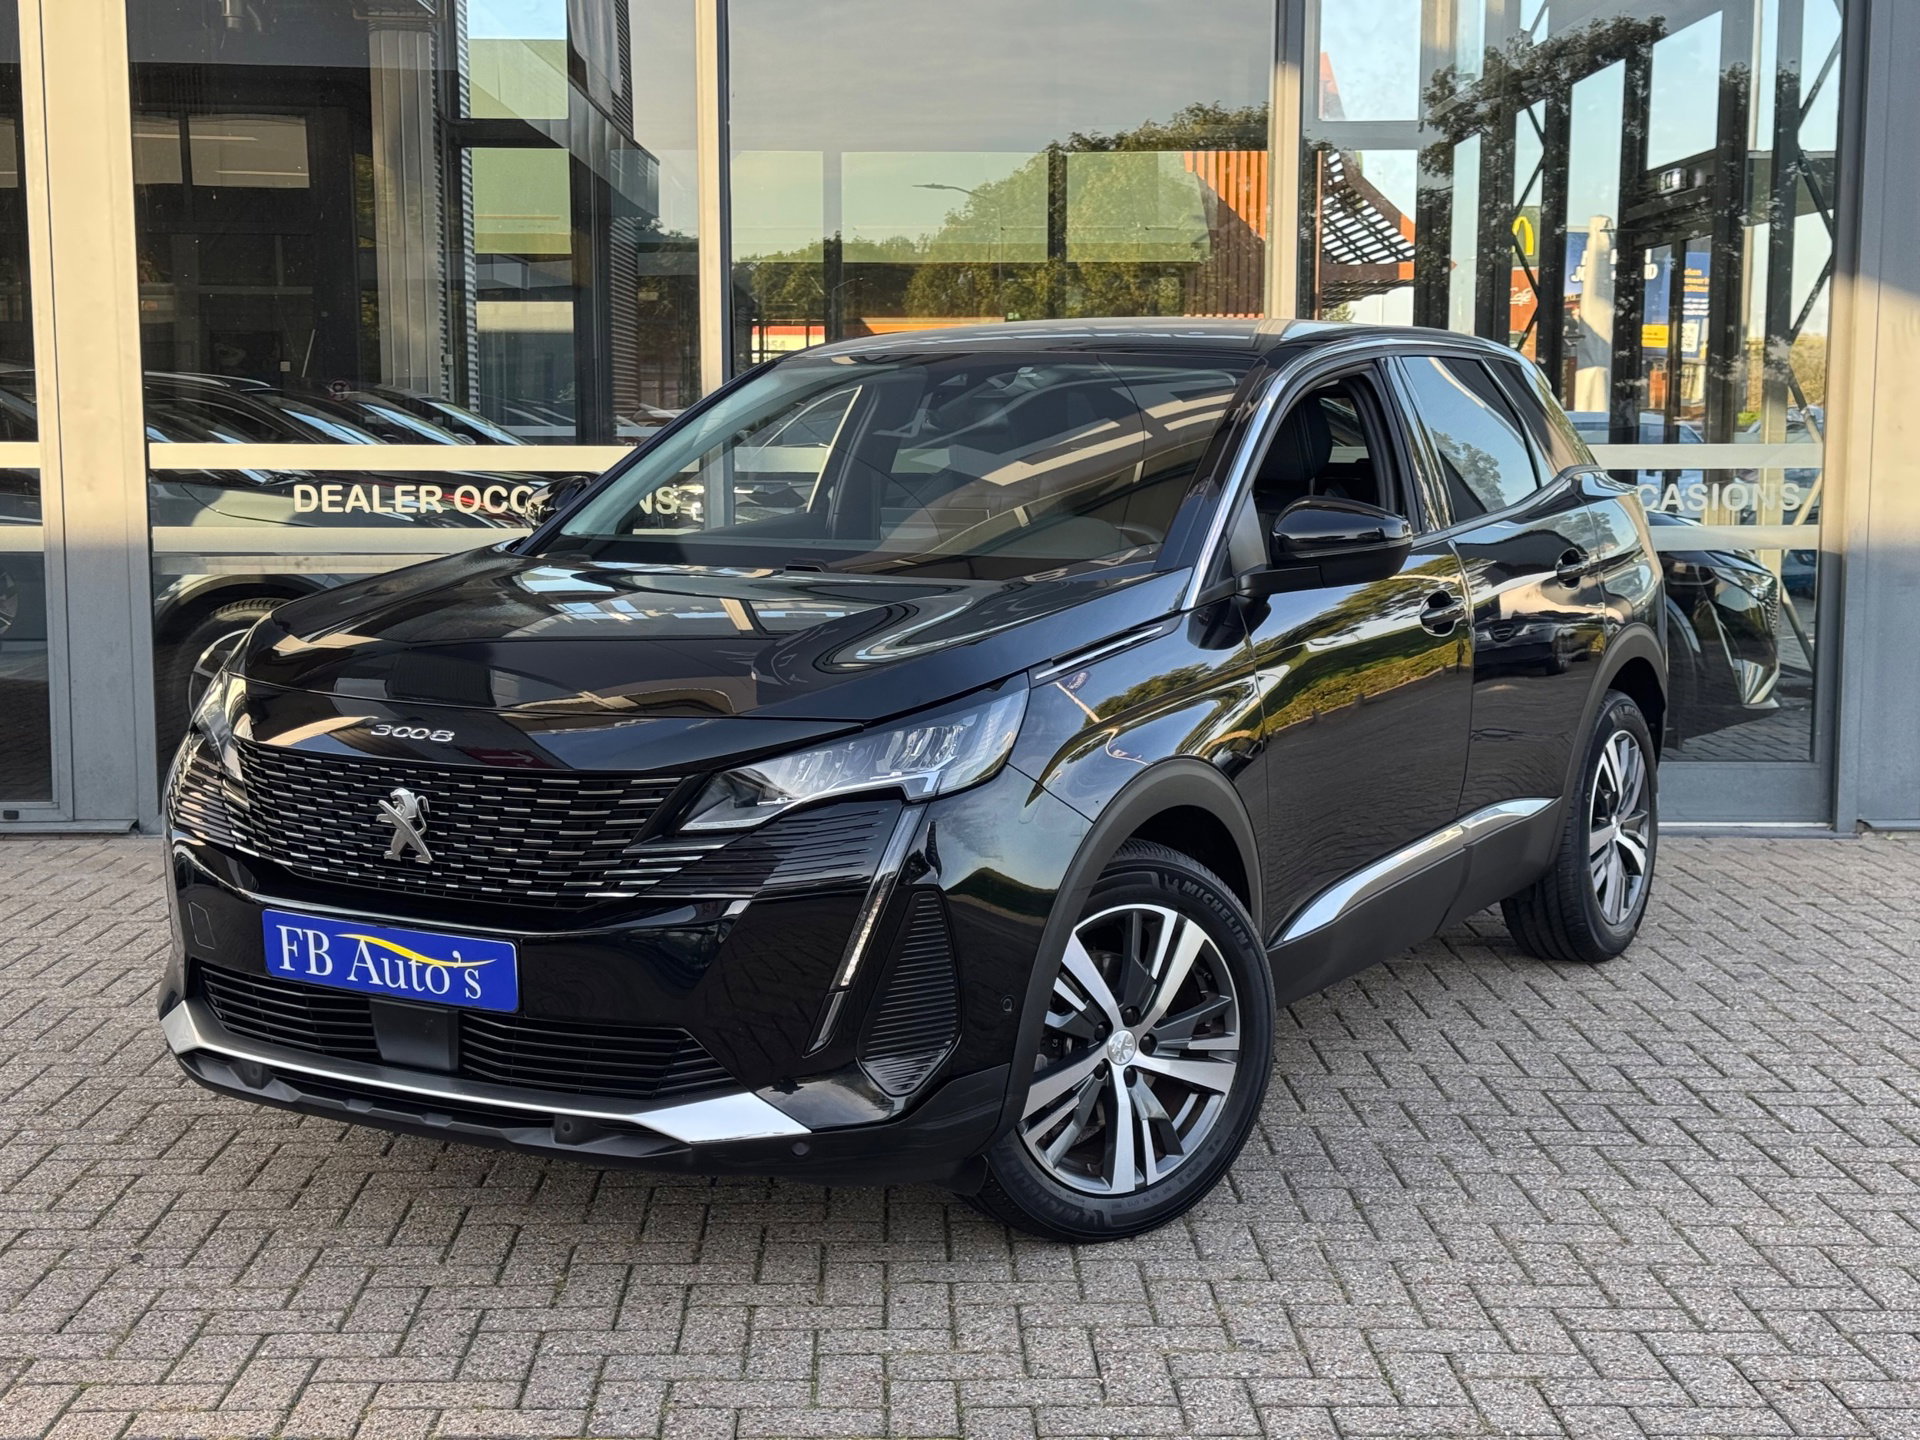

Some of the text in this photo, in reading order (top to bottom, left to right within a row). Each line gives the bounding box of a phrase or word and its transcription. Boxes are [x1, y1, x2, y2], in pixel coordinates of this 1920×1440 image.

[293, 484, 443, 514] DEALER
[370, 724, 456, 742] 3008
[1181, 880, 1249, 945] MICHELIN
[276, 924, 482, 1000] FB Auto's
